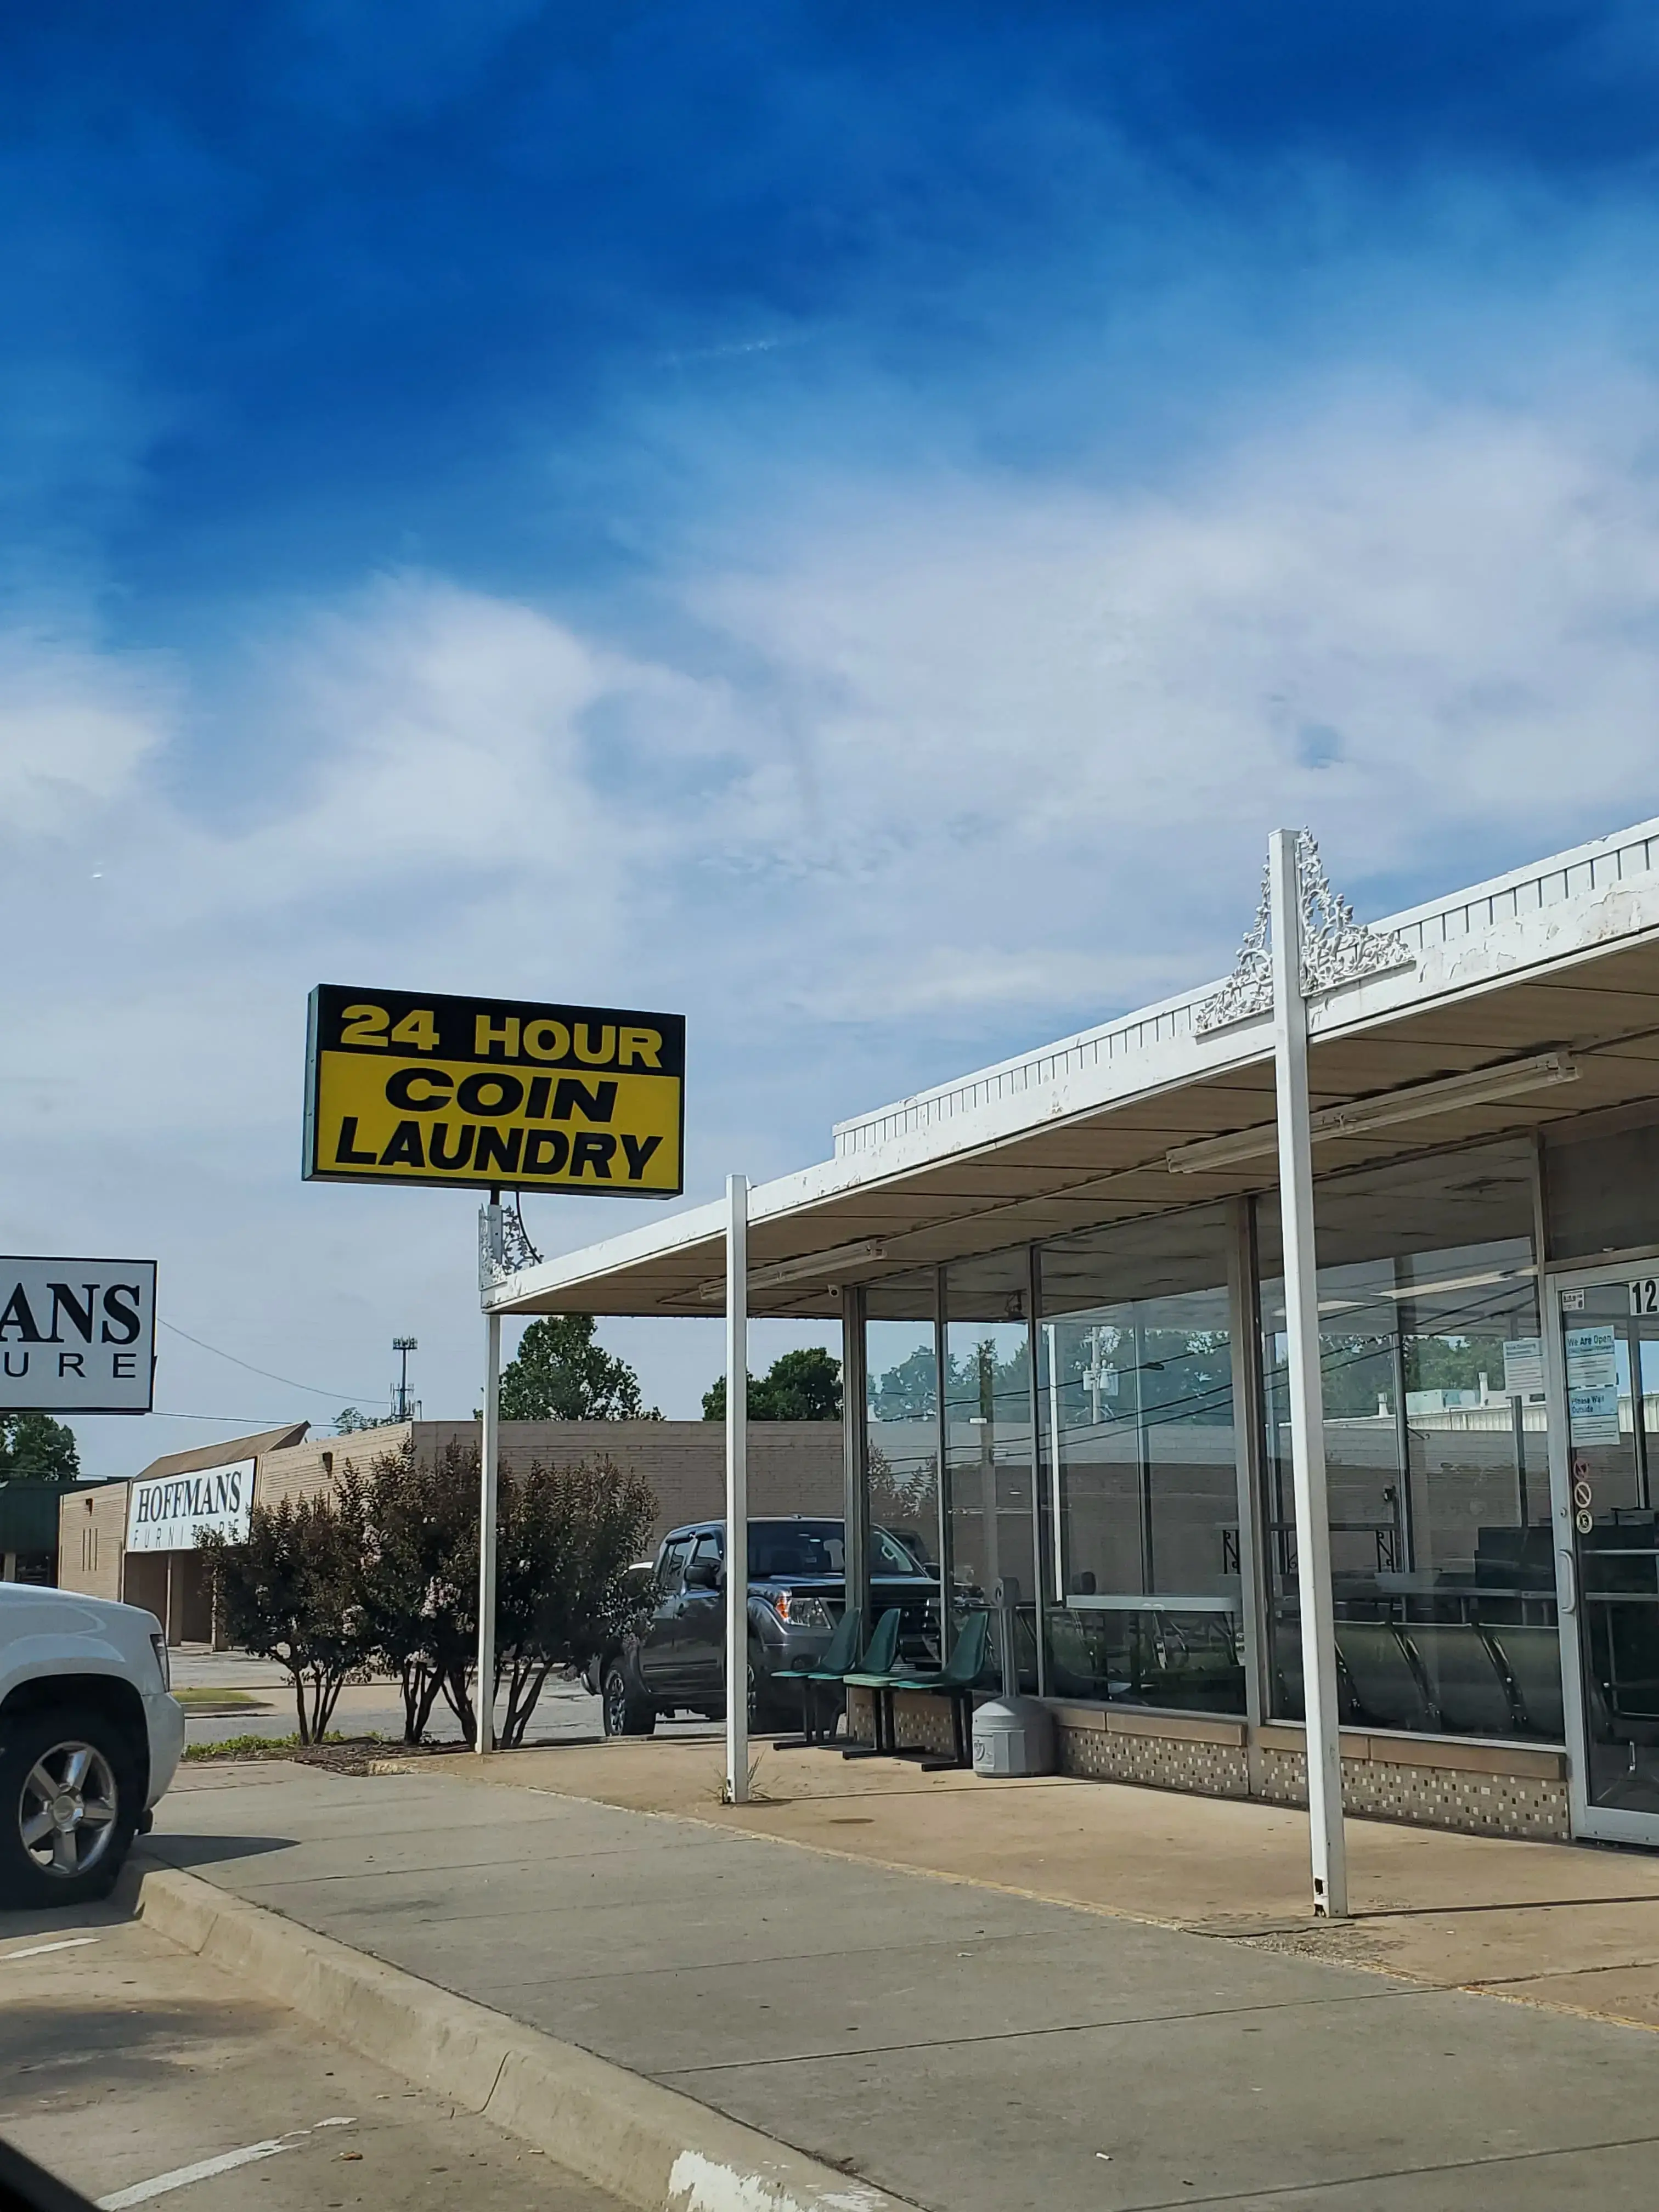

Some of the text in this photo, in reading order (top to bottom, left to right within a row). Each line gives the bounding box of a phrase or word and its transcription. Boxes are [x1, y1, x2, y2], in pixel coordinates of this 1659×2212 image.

[341, 1005, 663, 1069] 24 HOUR
[385, 1067, 618, 1124] COIN
[335, 1116, 663, 1181] LAUNDRY
[1632, 1280, 1658, 1314] 12
[1580, 1336, 1592, 1345] Are
[1594, 1334, 1612, 1345] Open
[136, 1470, 242, 1523] HOFFMANS
